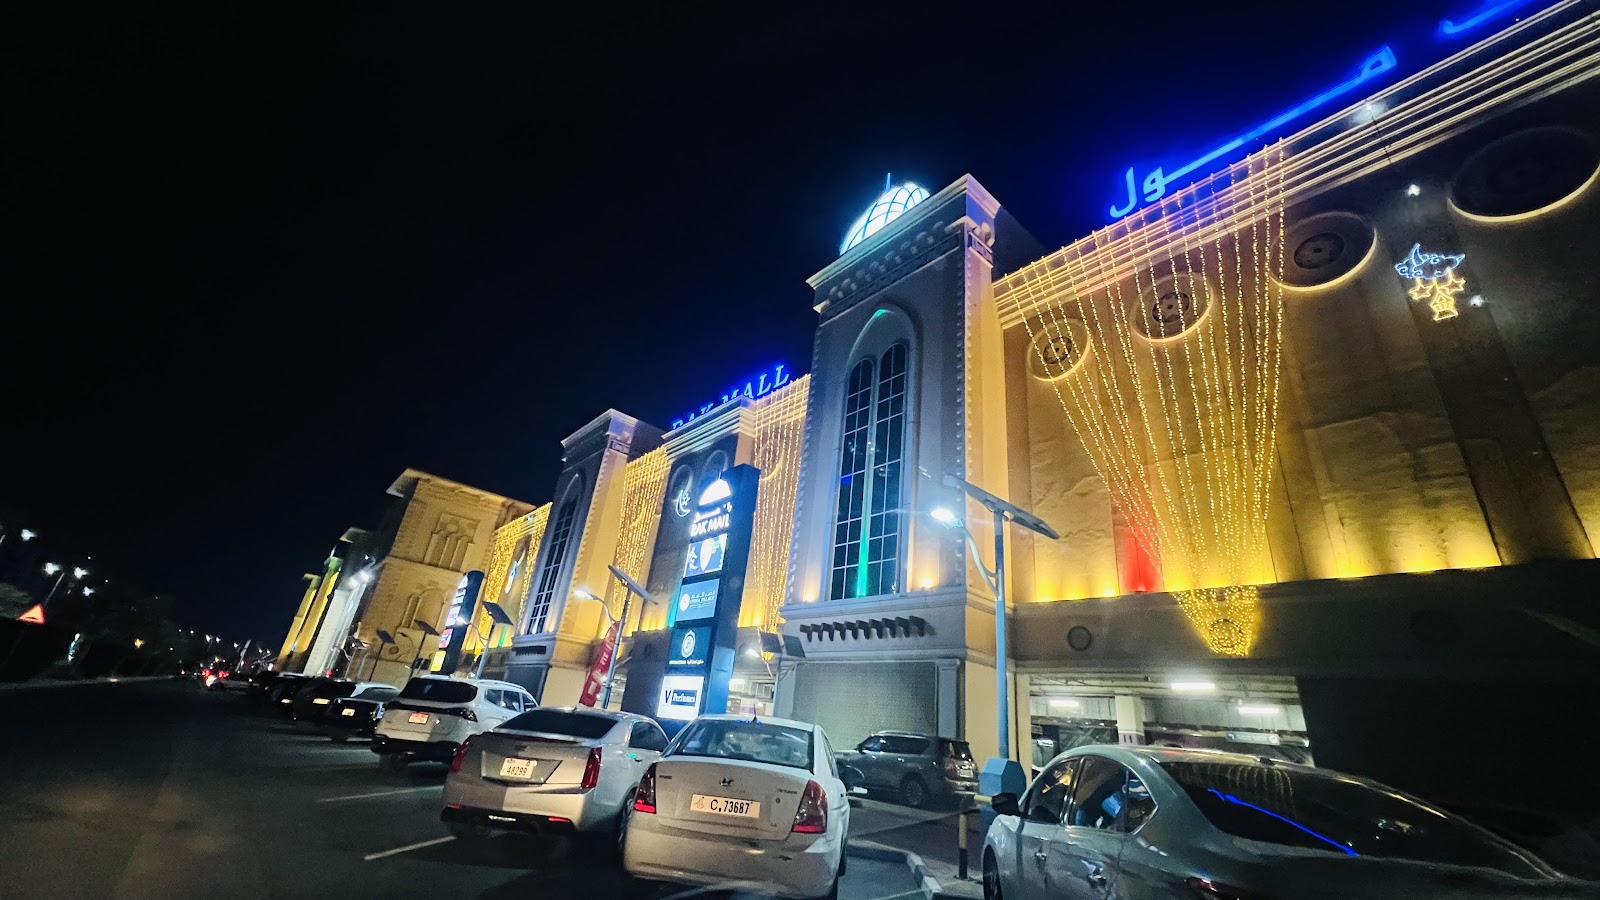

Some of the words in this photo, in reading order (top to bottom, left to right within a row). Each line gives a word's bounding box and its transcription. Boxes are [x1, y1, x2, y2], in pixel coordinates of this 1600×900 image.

[1110, 46, 1397, 218] مول
[665, 690, 671, 703] V
[506, 766, 528, 777] 48299
